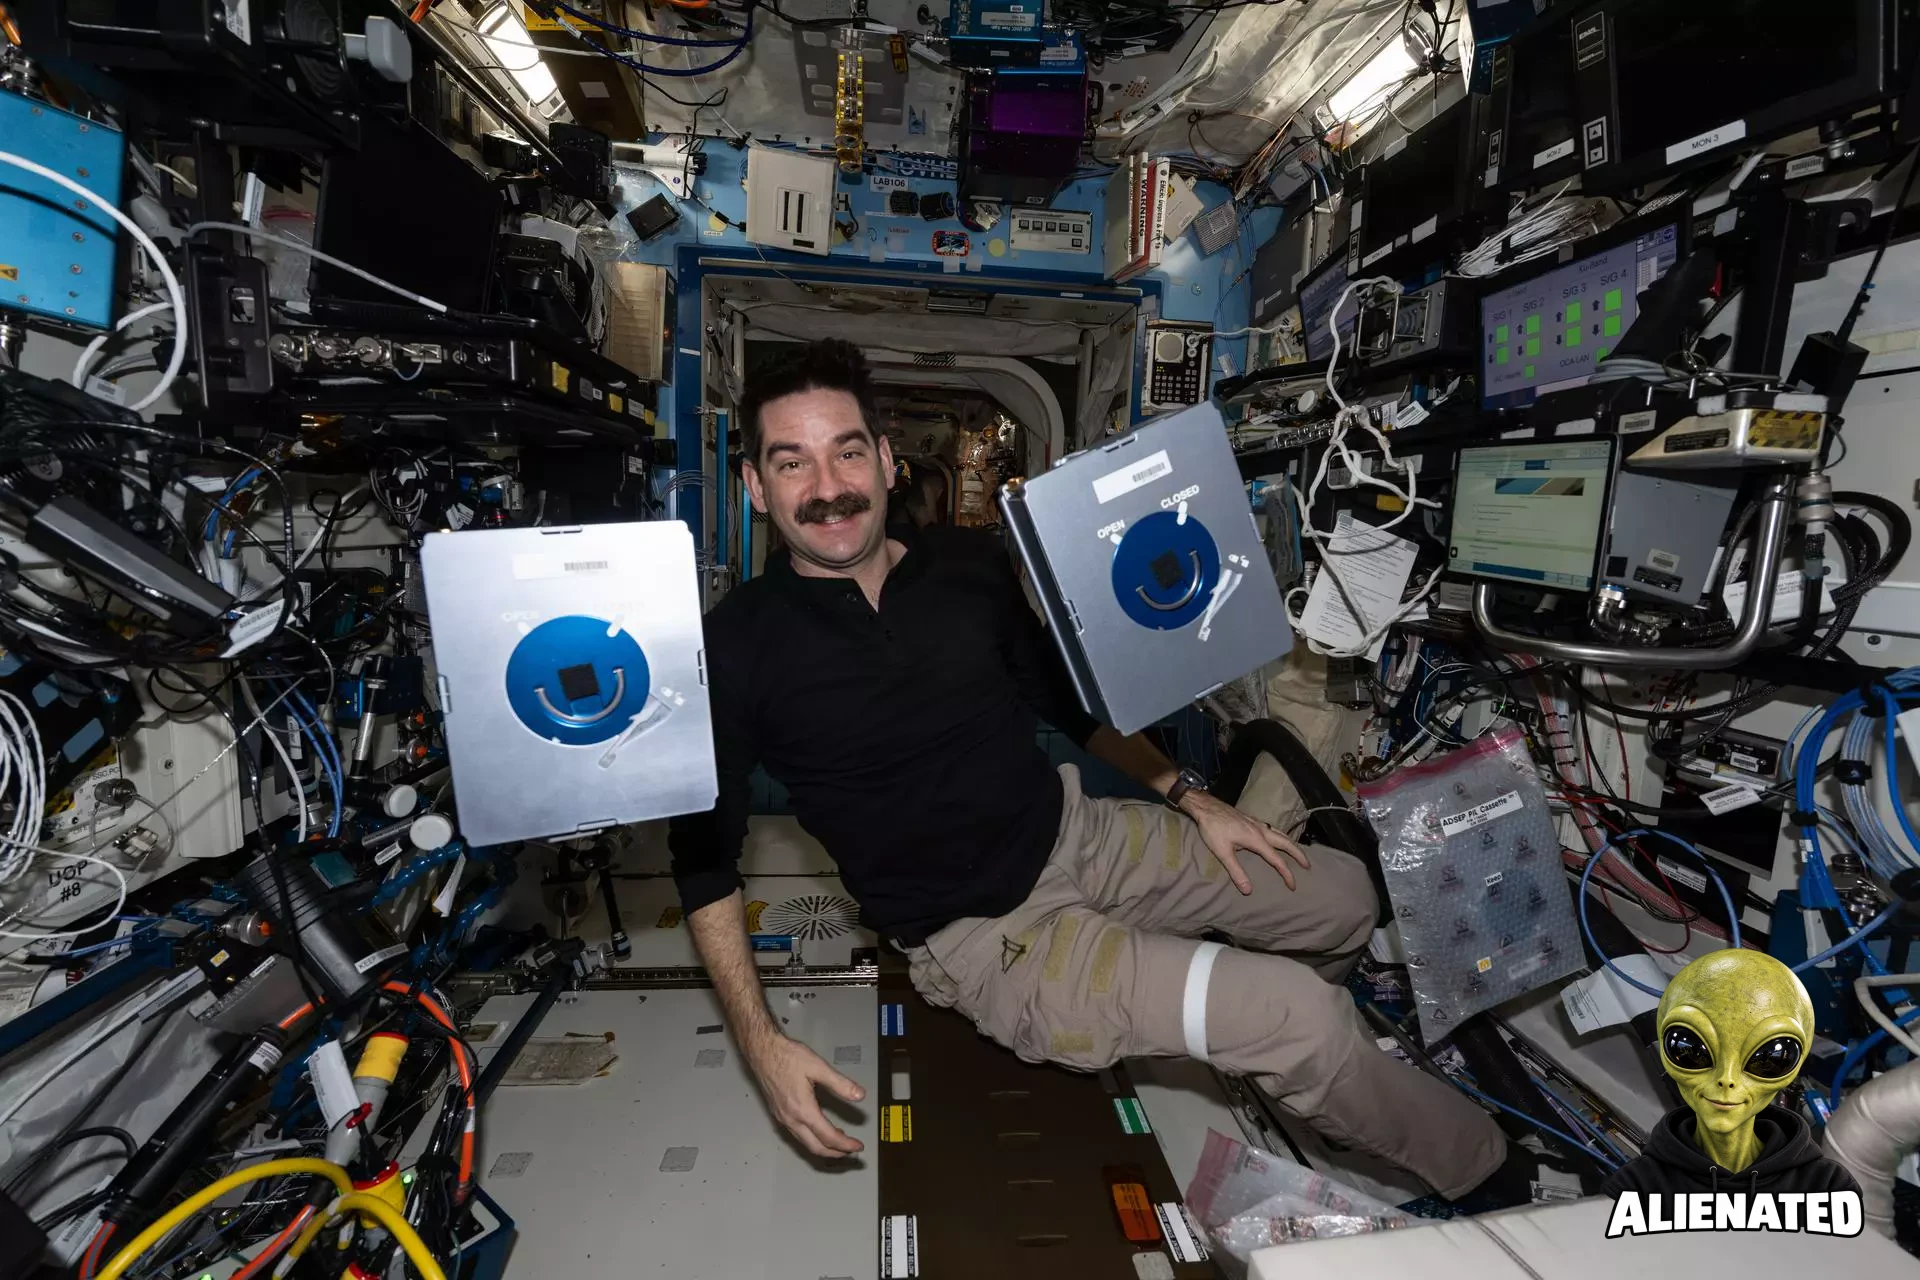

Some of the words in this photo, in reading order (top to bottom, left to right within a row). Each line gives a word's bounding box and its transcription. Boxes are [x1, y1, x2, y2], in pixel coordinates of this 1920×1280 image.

[1691, 138, 1713, 150] MON
[1714, 134, 1719, 142] 3
[1139, 179, 1148, 237] WARNING
[1160, 484, 1200, 509] CLOSED
[1096, 519, 1125, 539] OPEN
[1443, 813, 1466, 826] ADSEP
[1480, 798, 1508, 813] Cassette
[49, 860, 88, 888] UOP
[60, 882, 81, 902] #8
